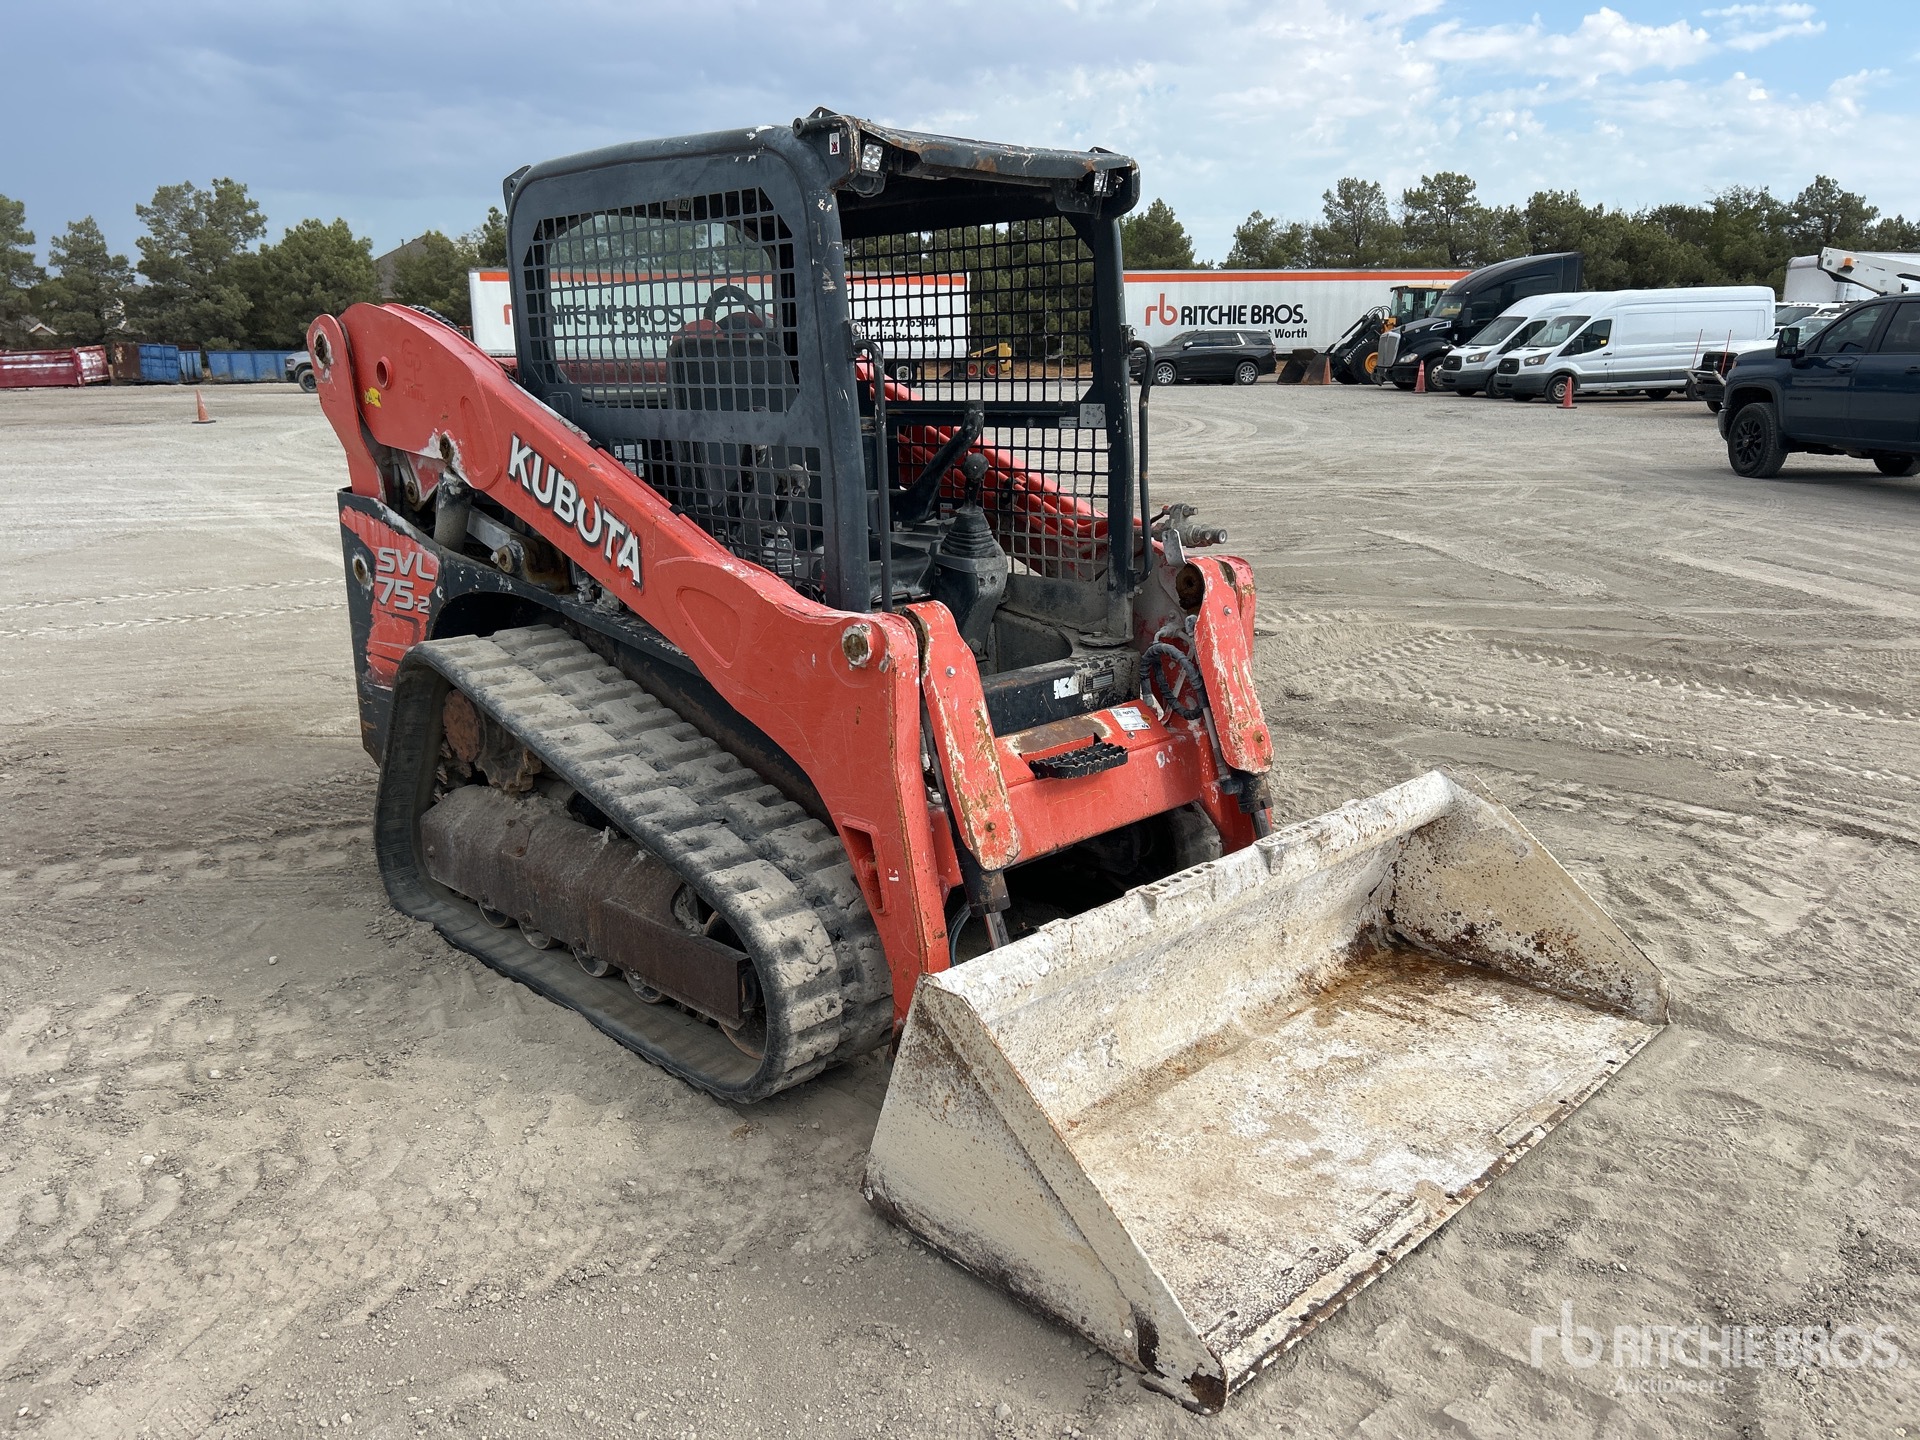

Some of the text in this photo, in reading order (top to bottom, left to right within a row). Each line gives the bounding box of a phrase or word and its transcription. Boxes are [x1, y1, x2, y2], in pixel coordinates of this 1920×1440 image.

[1180, 305, 1247, 326] RITCHIE
[1250, 304, 1308, 325] BROS.
[1274, 329, 1308, 339] Worth
[508, 434, 642, 585] KUBOTA
[376, 546, 435, 581] SVL
